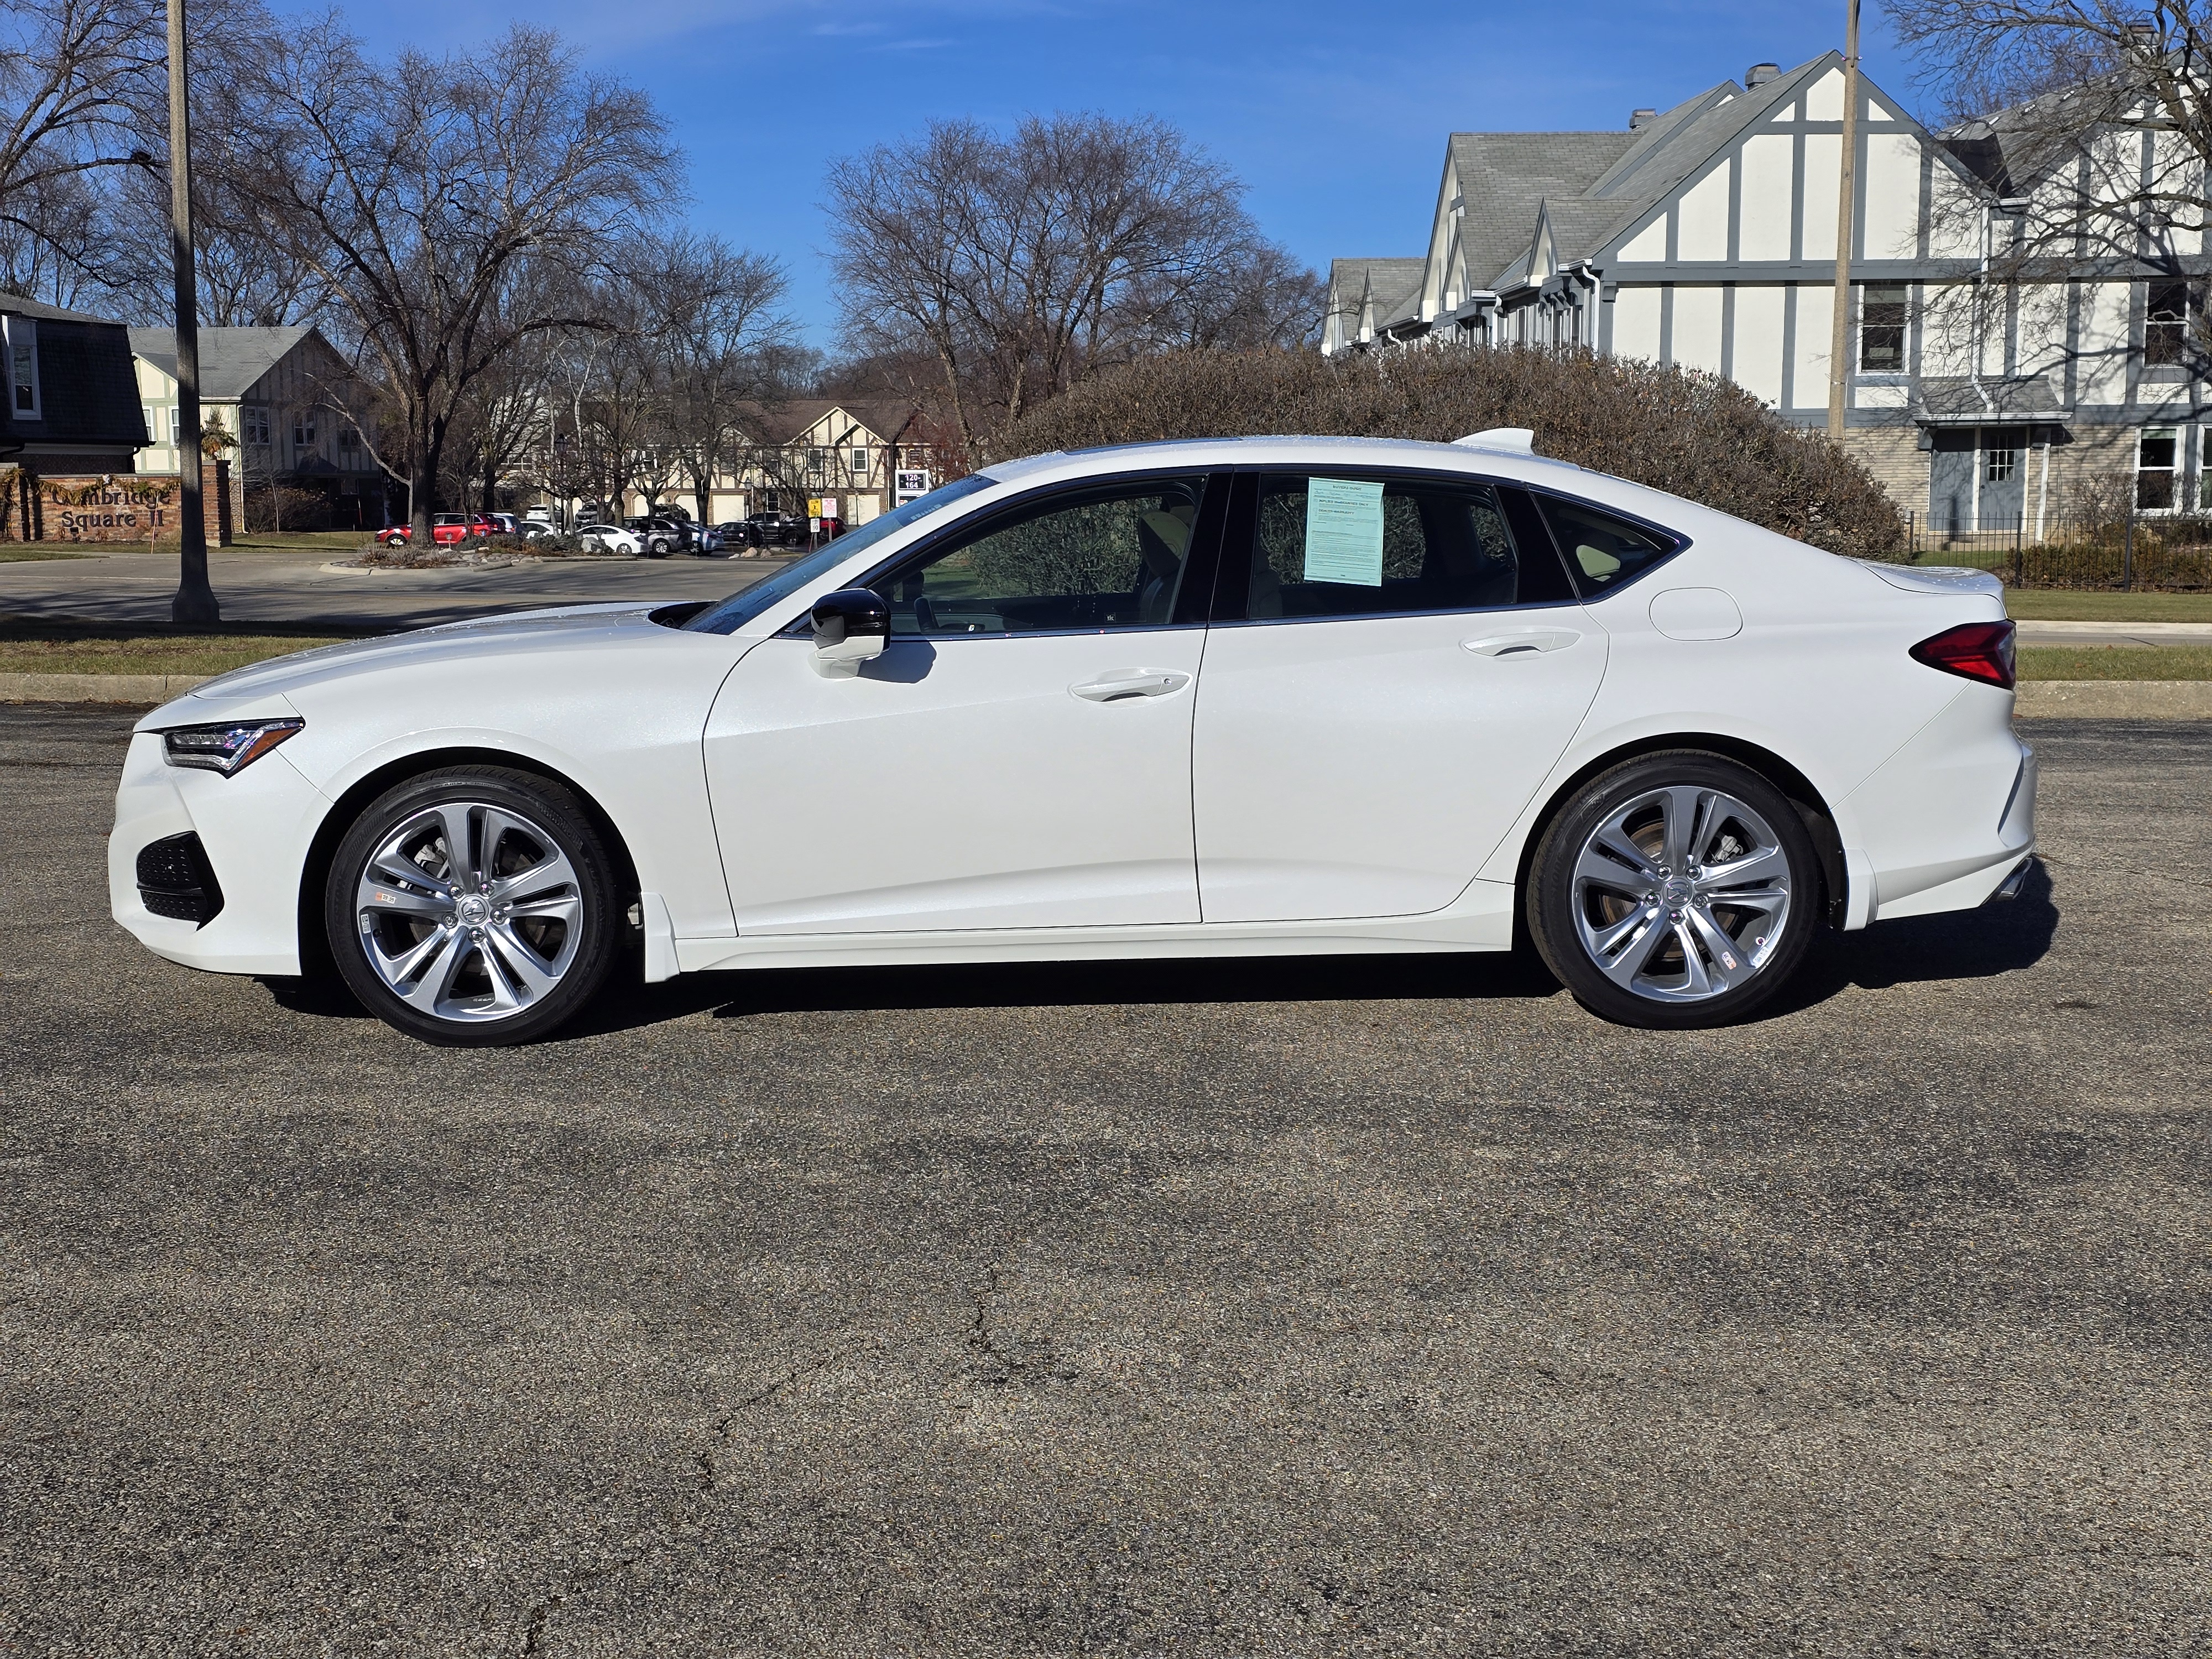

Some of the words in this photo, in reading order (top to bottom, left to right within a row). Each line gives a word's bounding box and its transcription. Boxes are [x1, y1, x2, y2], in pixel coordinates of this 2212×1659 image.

[52, 488, 170, 509] Cmbridge
[61, 511, 137, 532] Square
[149, 509, 165, 527] II
